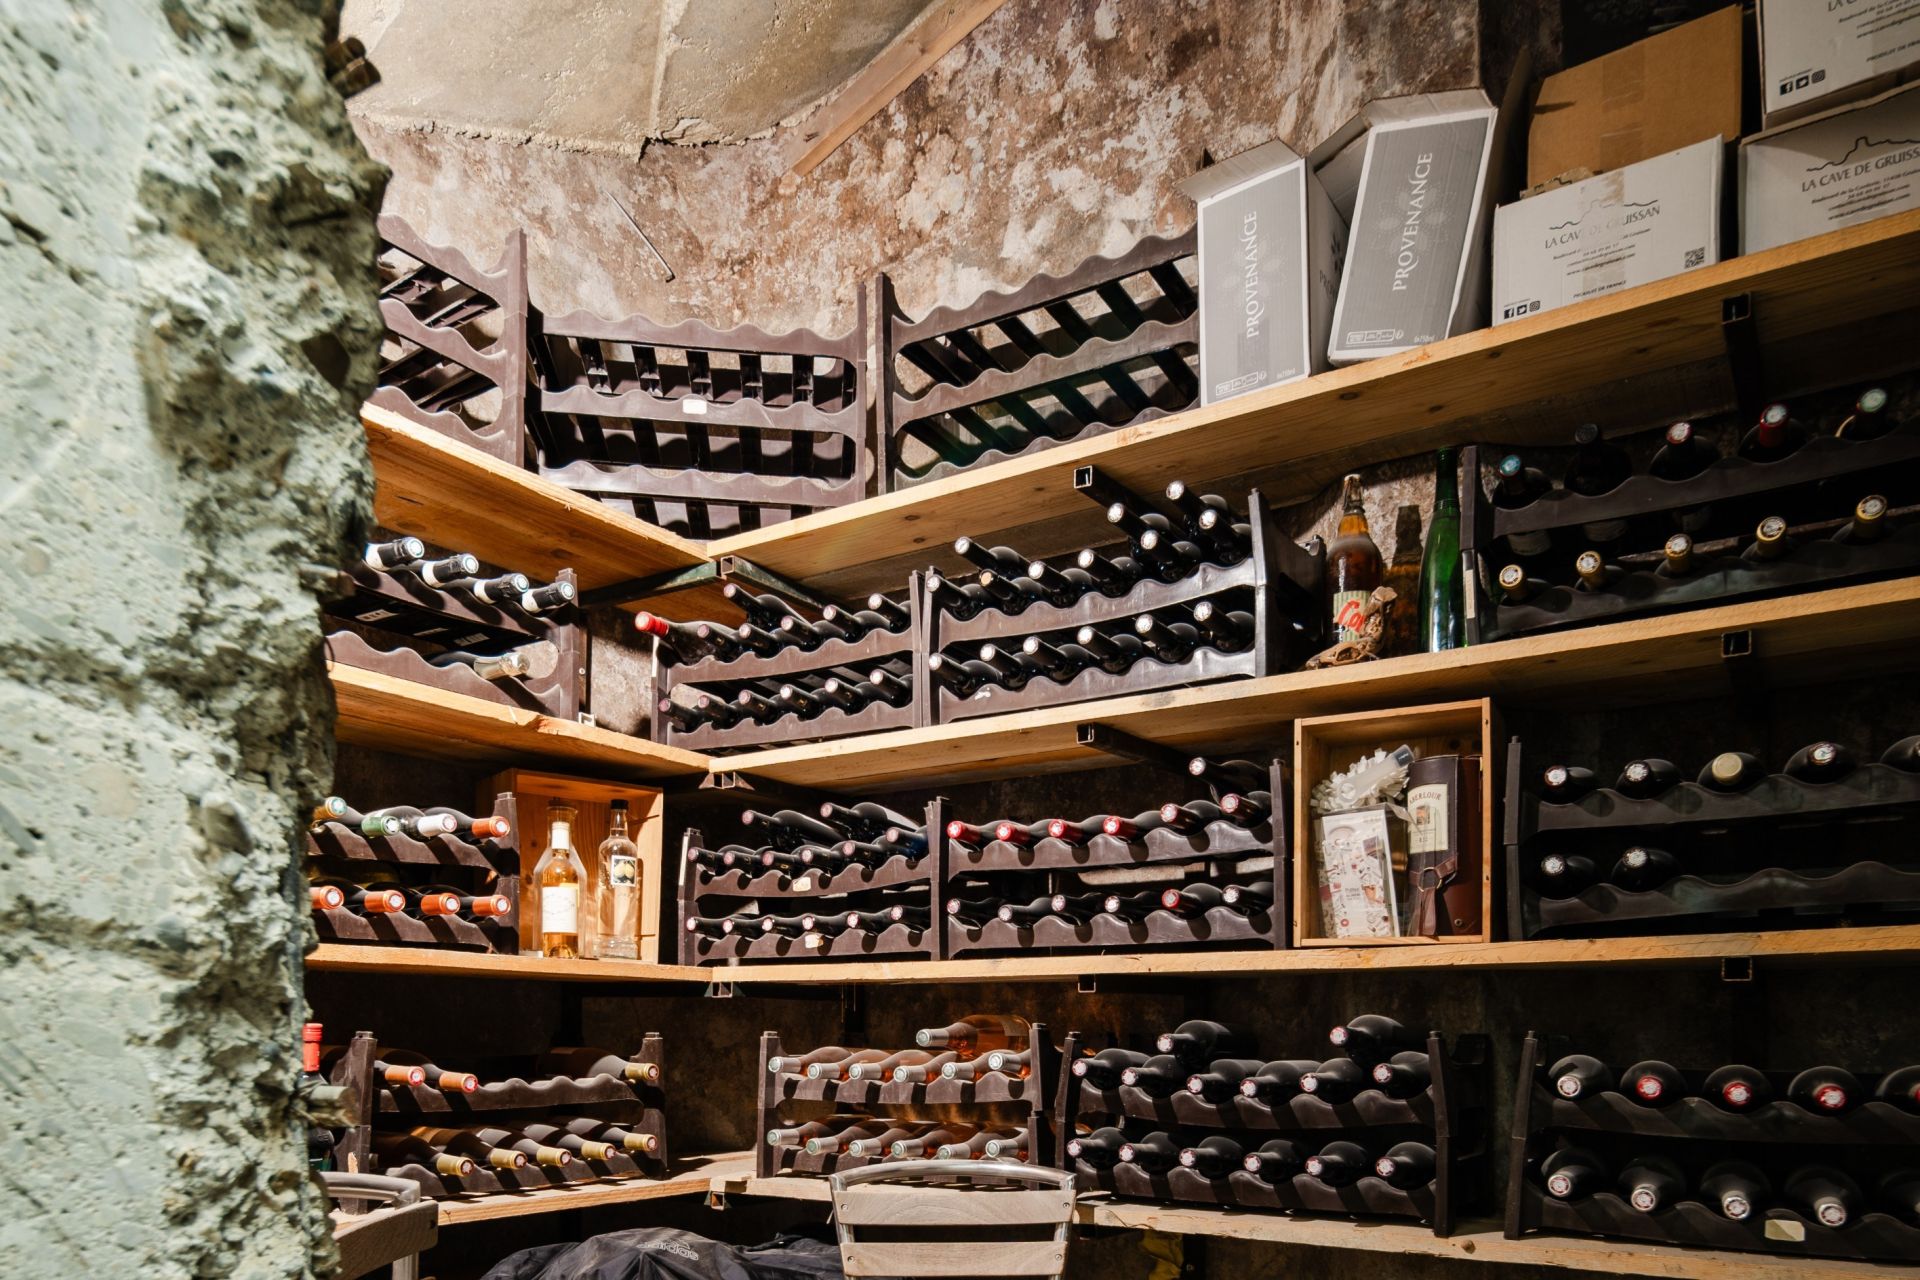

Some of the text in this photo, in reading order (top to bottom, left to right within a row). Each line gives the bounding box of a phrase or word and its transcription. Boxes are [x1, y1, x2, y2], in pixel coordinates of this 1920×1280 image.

[1801, 179, 1817, 193] LA
[1819, 168, 1852, 187] CAVE
[1854, 162, 1873, 176] DE
[1874, 146, 1920, 170] GRUISS
[1393, 152, 1433, 292] PROVENANCE
[1545, 235, 1558, 249] LA
[1241, 211, 1265, 339] PROVENANCE
